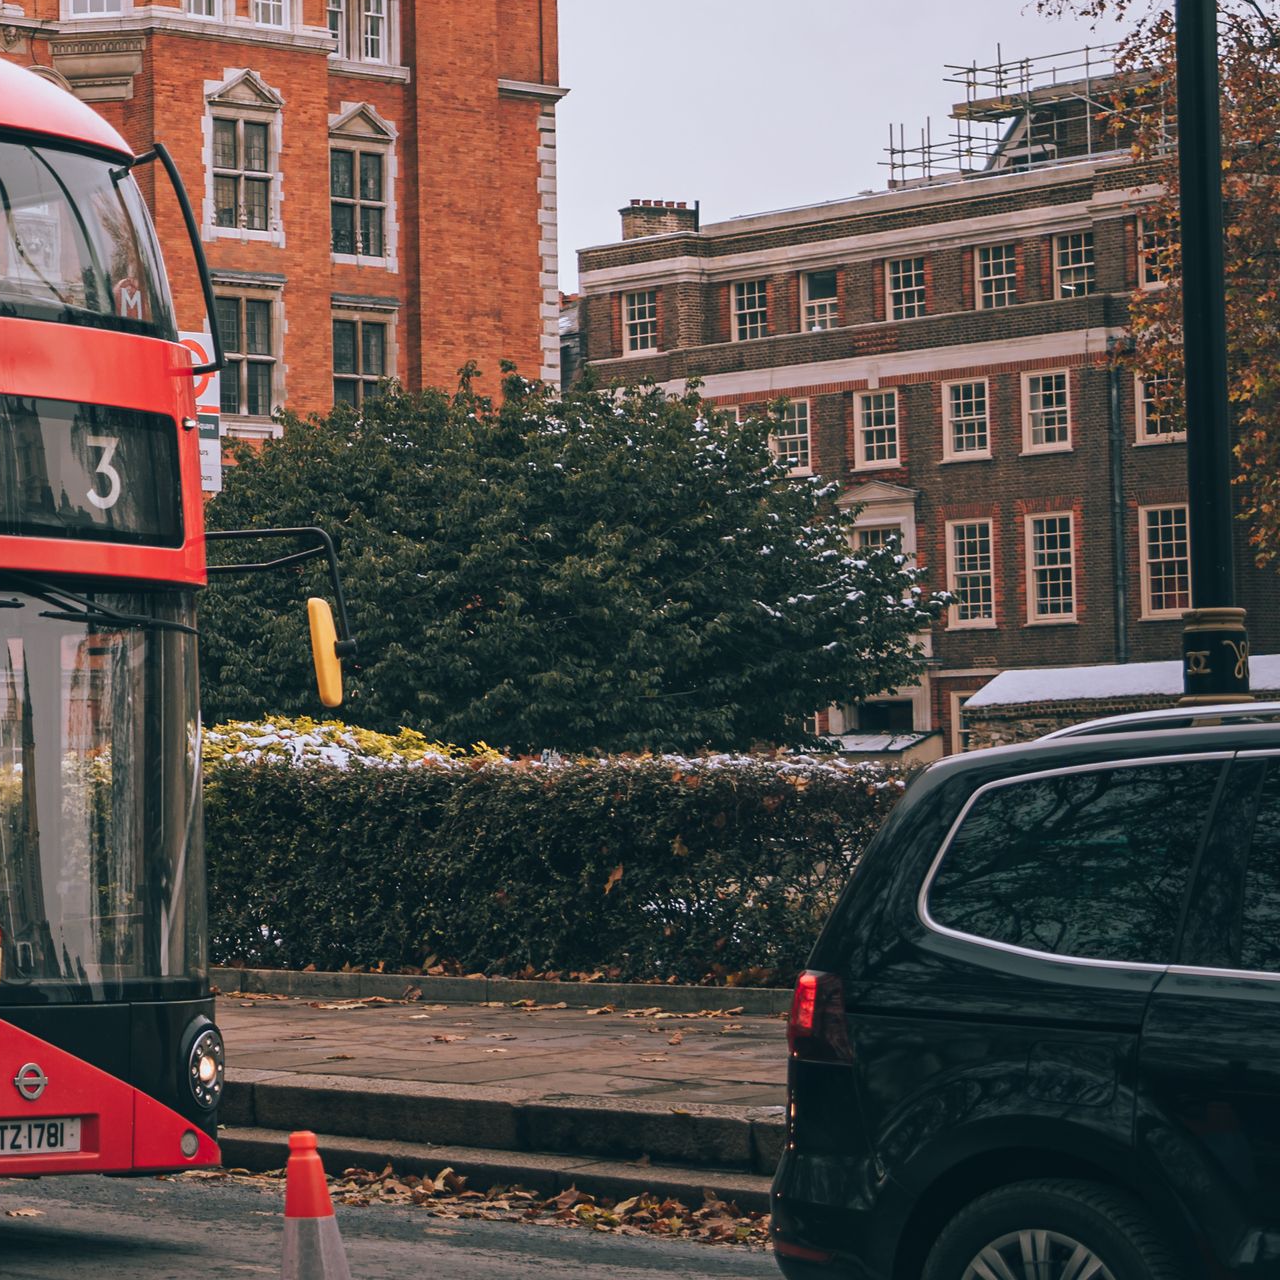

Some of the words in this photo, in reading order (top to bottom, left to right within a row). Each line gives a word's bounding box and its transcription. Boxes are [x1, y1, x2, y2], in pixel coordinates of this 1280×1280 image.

[120, 287, 142, 320] M
[86, 435, 121, 510] 3
[27, 1122, 64, 1149] 1781
